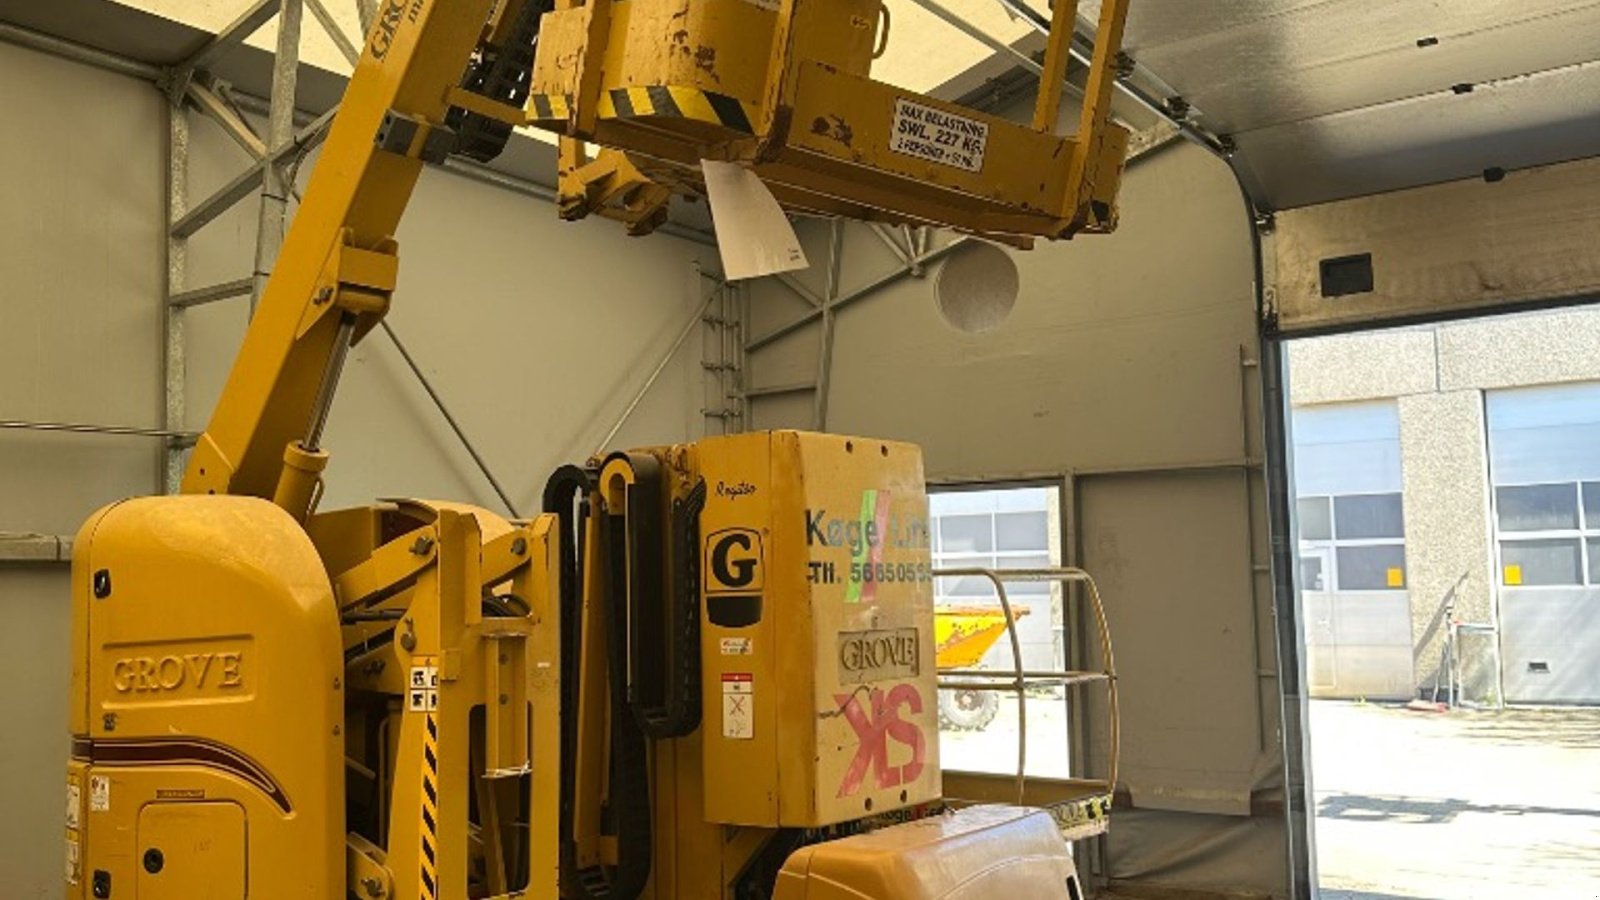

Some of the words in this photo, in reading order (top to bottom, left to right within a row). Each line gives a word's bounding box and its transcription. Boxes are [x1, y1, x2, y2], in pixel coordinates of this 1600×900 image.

[898, 119, 930, 141] SWL.
[935, 129, 961, 147] 227
[901, 104, 924, 121] MAX
[925, 110, 985, 138] BELASTNING
[804, 509, 880, 558] Køge
[712, 533, 758, 589] G
[113, 651, 243, 693] GROVE
[841, 636, 914, 672] GROVE
